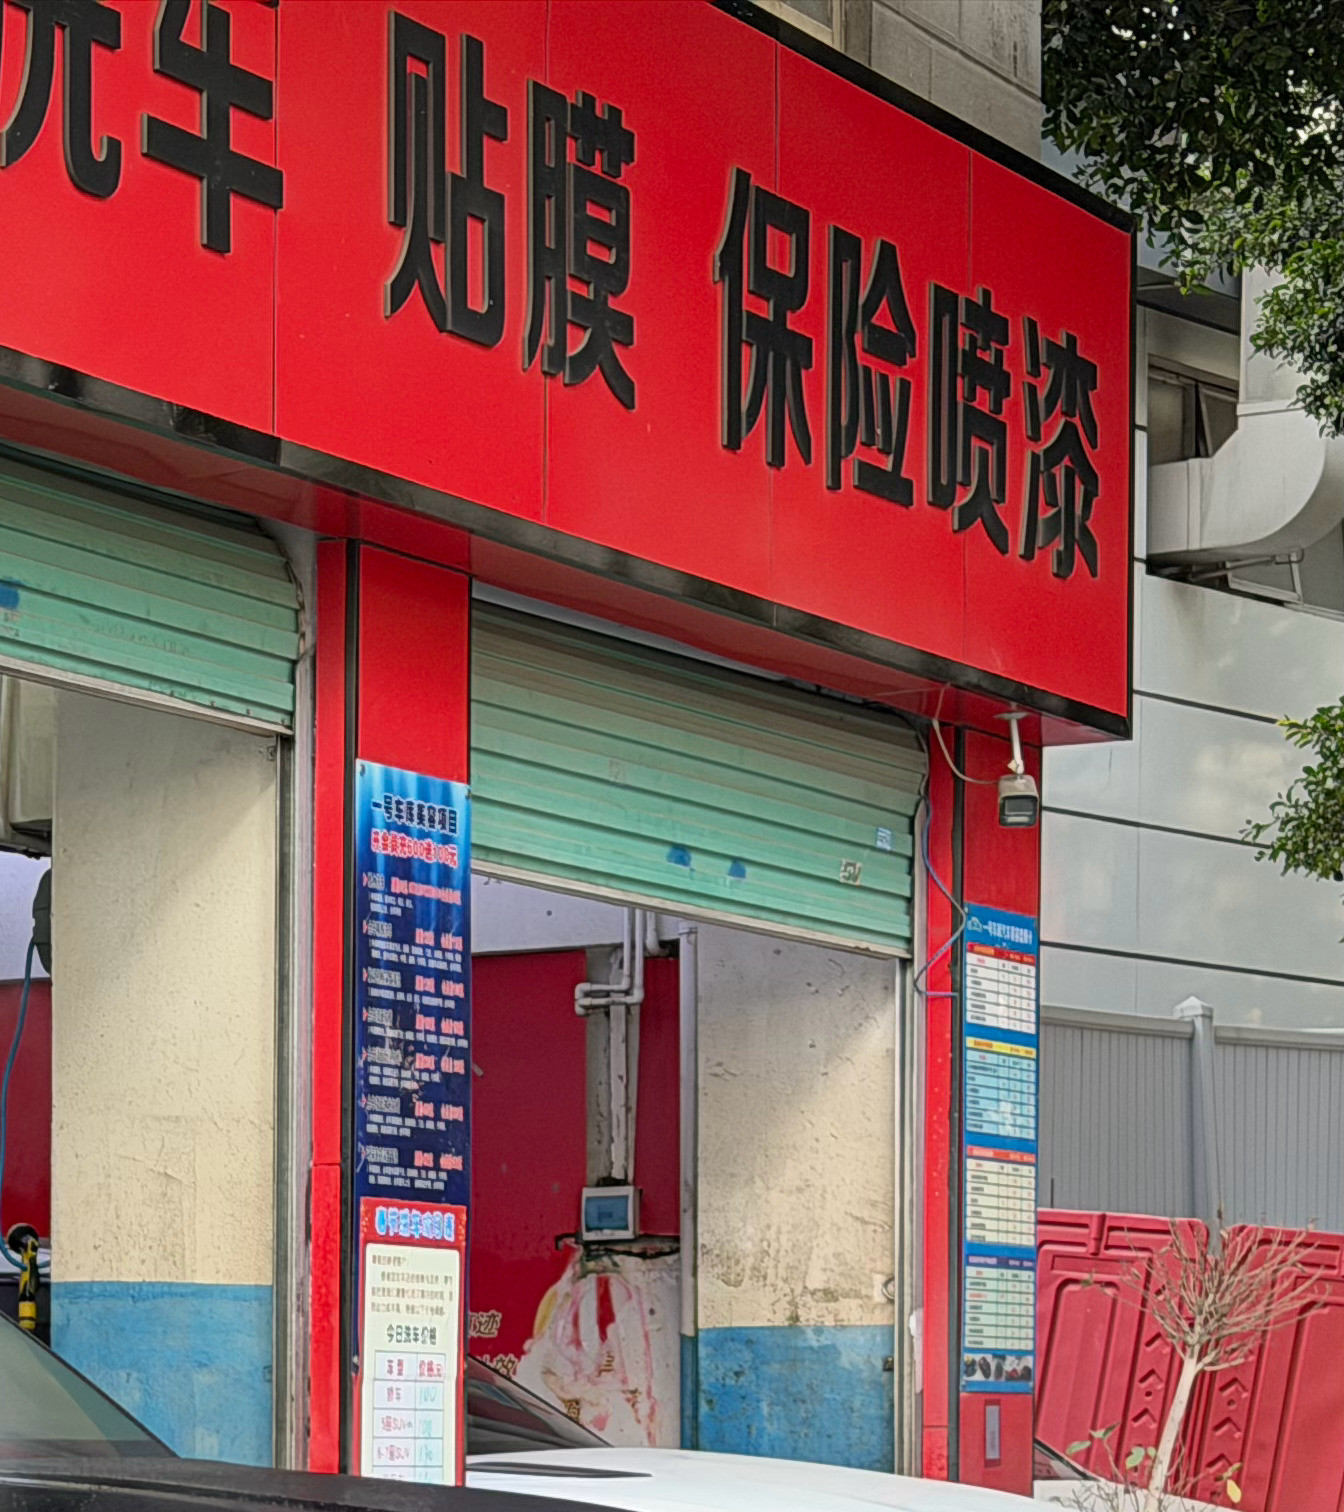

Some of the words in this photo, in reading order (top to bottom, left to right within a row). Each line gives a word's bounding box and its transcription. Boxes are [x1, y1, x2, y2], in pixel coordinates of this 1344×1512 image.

[384, 10, 635, 412] 贴膜
[712, 166, 1099, 580] 保险喷漆
